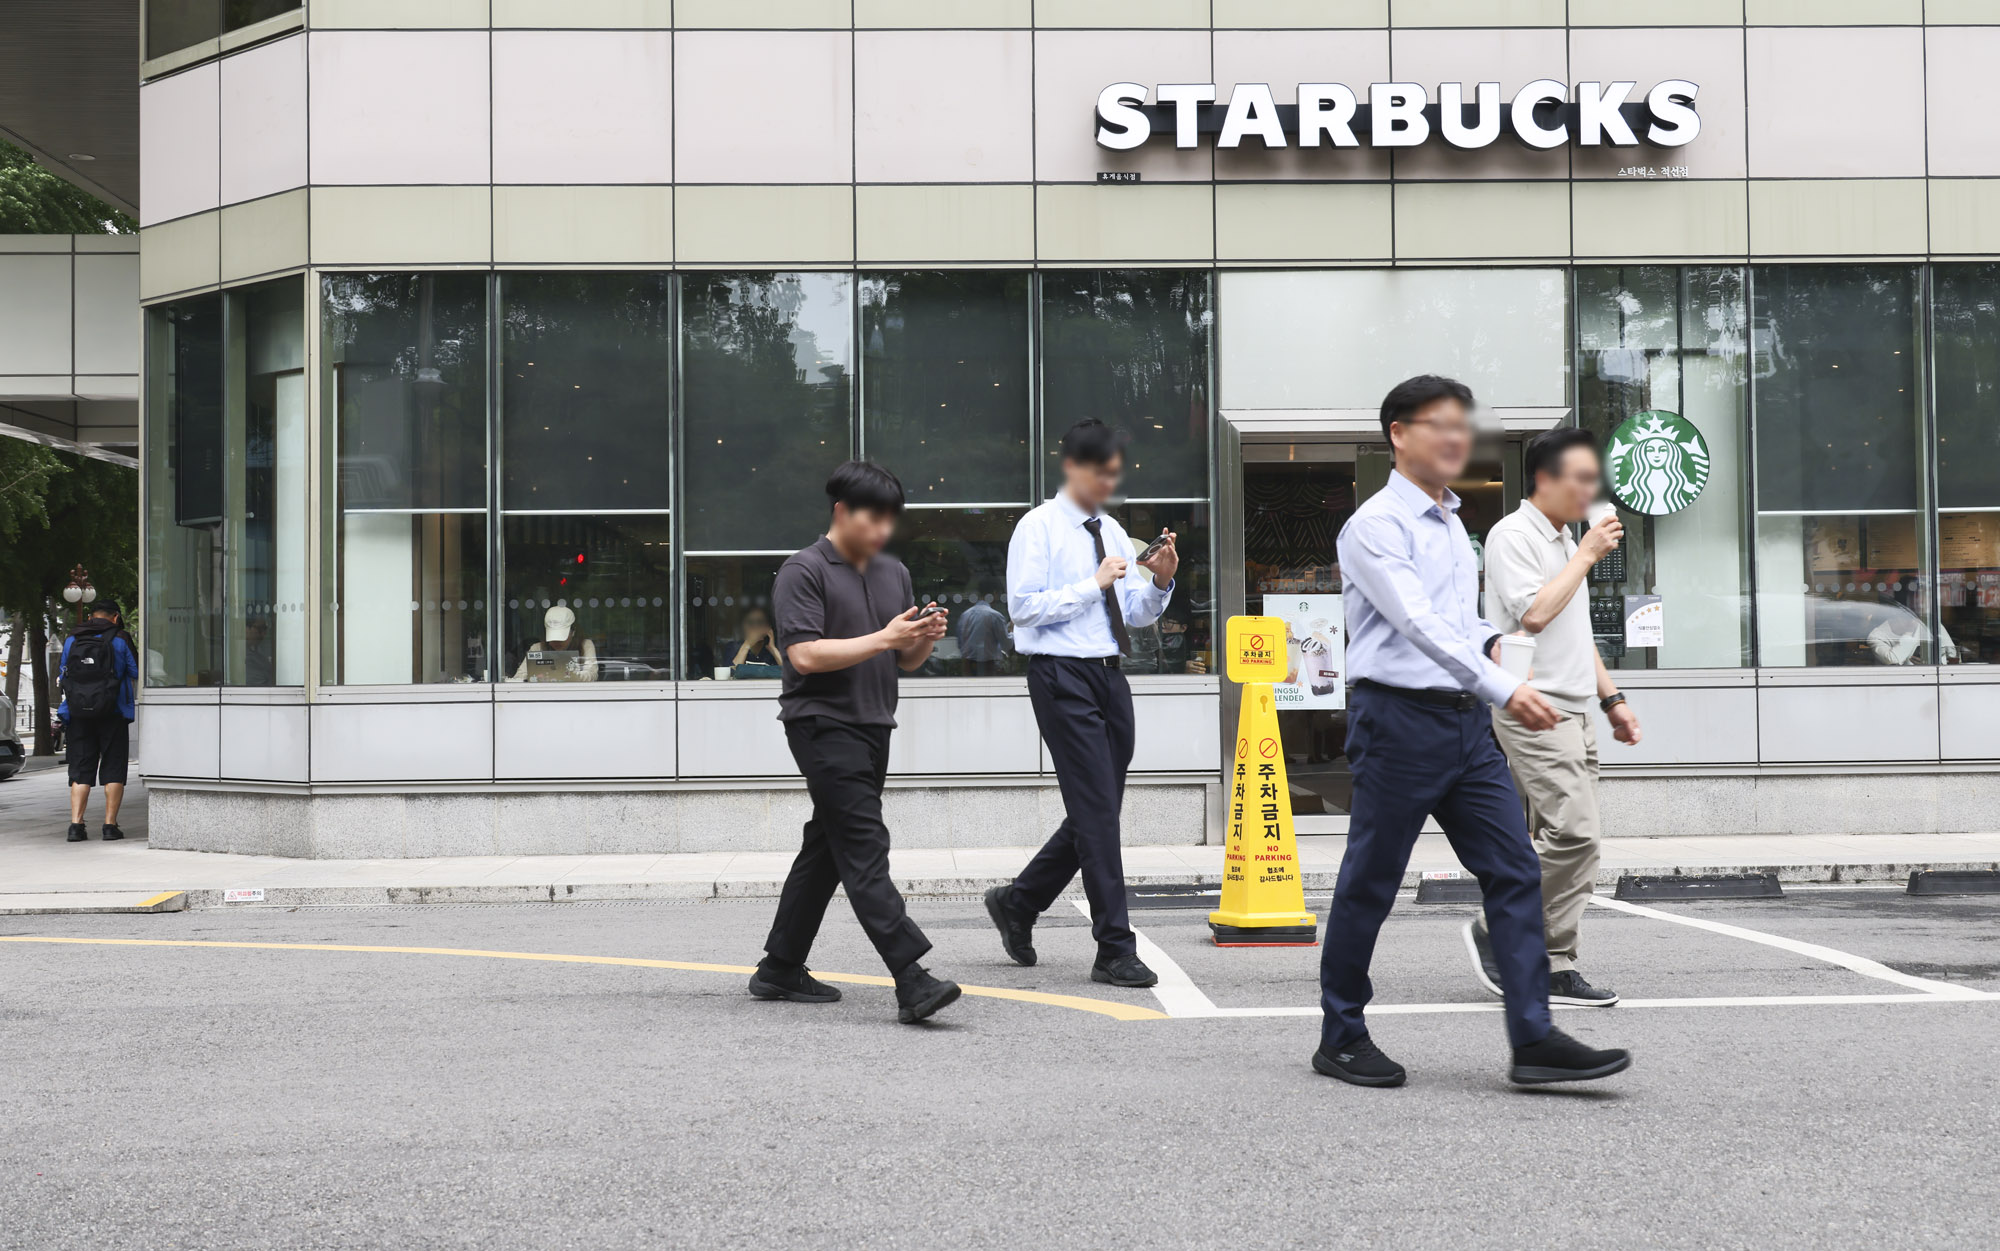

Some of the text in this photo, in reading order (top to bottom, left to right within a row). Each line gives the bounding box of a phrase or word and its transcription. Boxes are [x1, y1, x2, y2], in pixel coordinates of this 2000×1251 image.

[1096, 78, 1702, 150] STARBUCKS
[1617, 165, 1689, 178] 스타벅스 적선점
[1102, 173, 1136, 181] 휴게음식점
[1243, 650, 1271, 658] 주차금지
[1274, 687, 1299, 695] INGSU
[1274, 694, 1304, 702] LENDED
[1233, 763, 1246, 841] 주차금지
[1258, 763, 1281, 841] 주차금지
[1226, 853, 1246, 862] PARKING
[1267, 866, 1285, 874] 협조에
[1260, 874, 1294, 883] 감사드립니다
